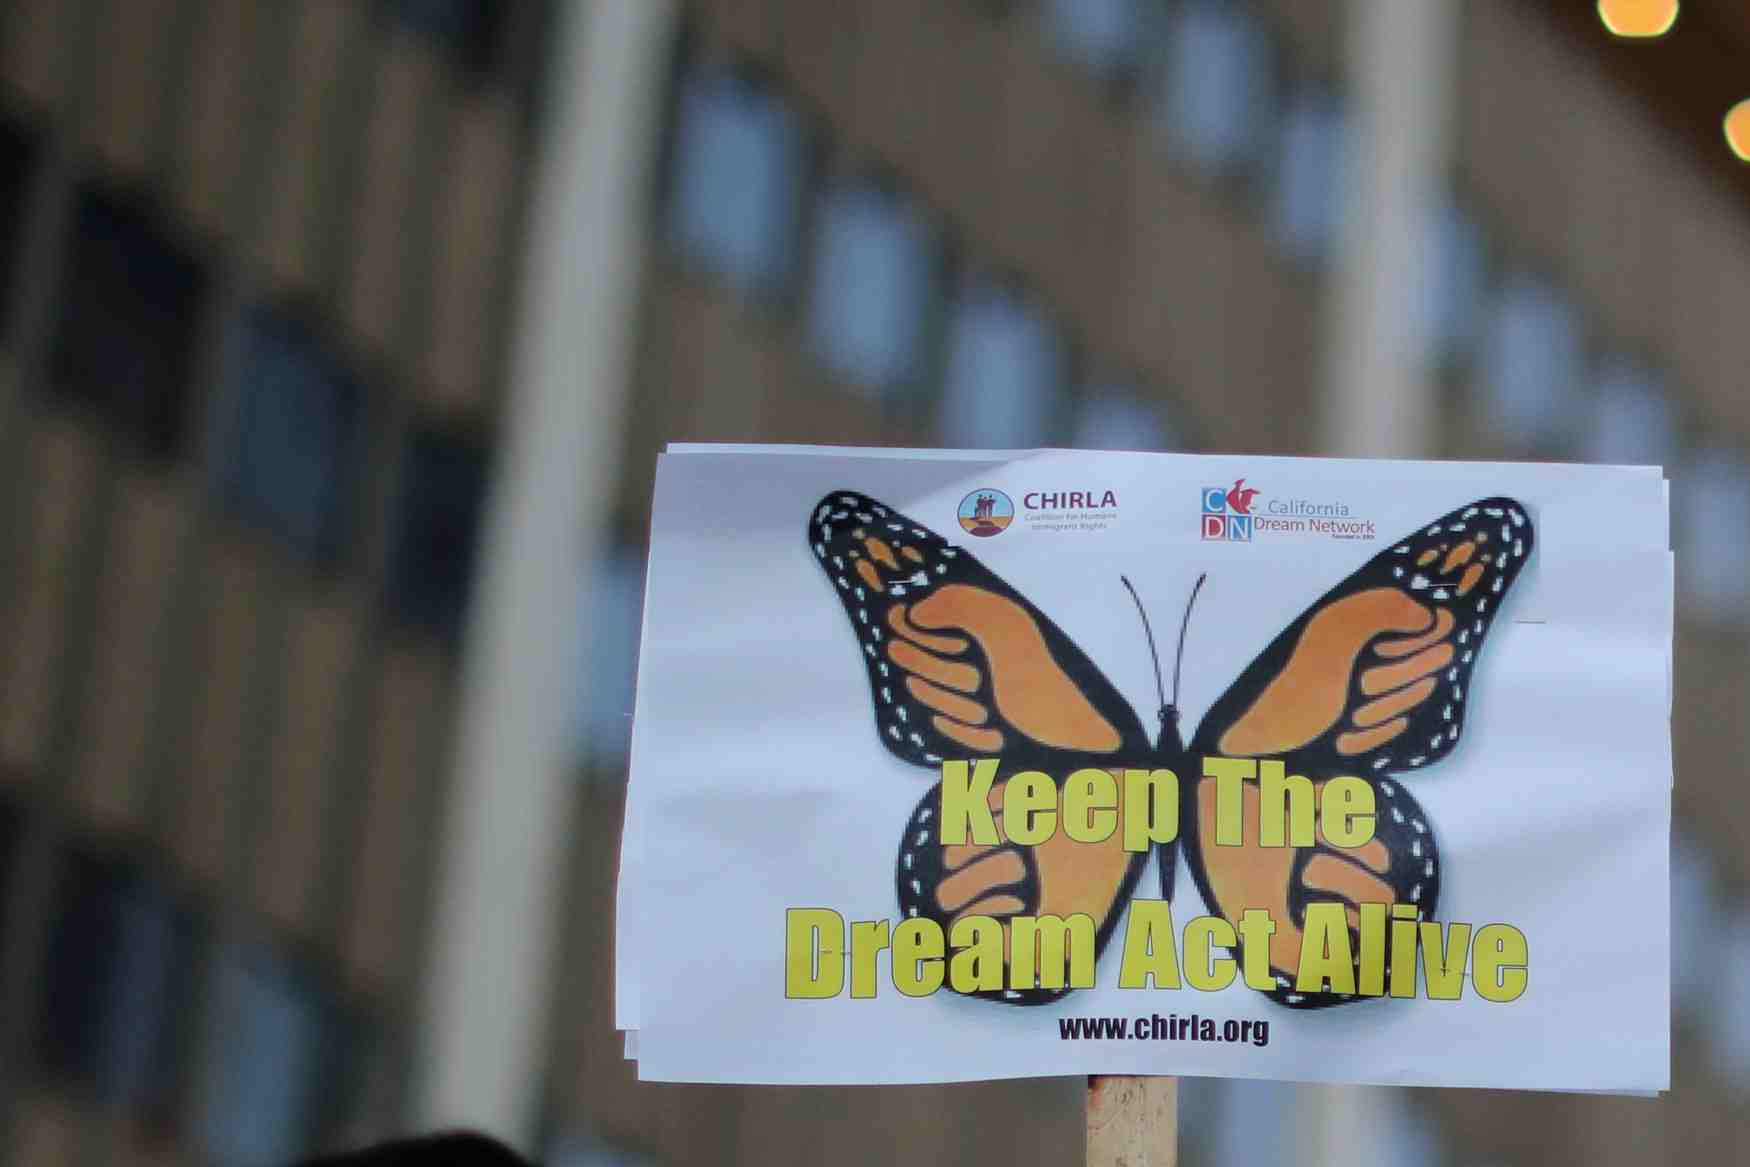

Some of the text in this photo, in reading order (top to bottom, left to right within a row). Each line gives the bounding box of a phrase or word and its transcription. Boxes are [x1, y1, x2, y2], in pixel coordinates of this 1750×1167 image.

[1023, 490, 1118, 511] CHIRLA
[1267, 499, 1350, 517] California
[1254, 516, 1376, 535] Dream Network
[938, 756, 1378, 852] Keep The
[784, 898, 1530, 1003] Dream Act Alive
[1058, 1012, 1270, 1048] www.chirla.org
